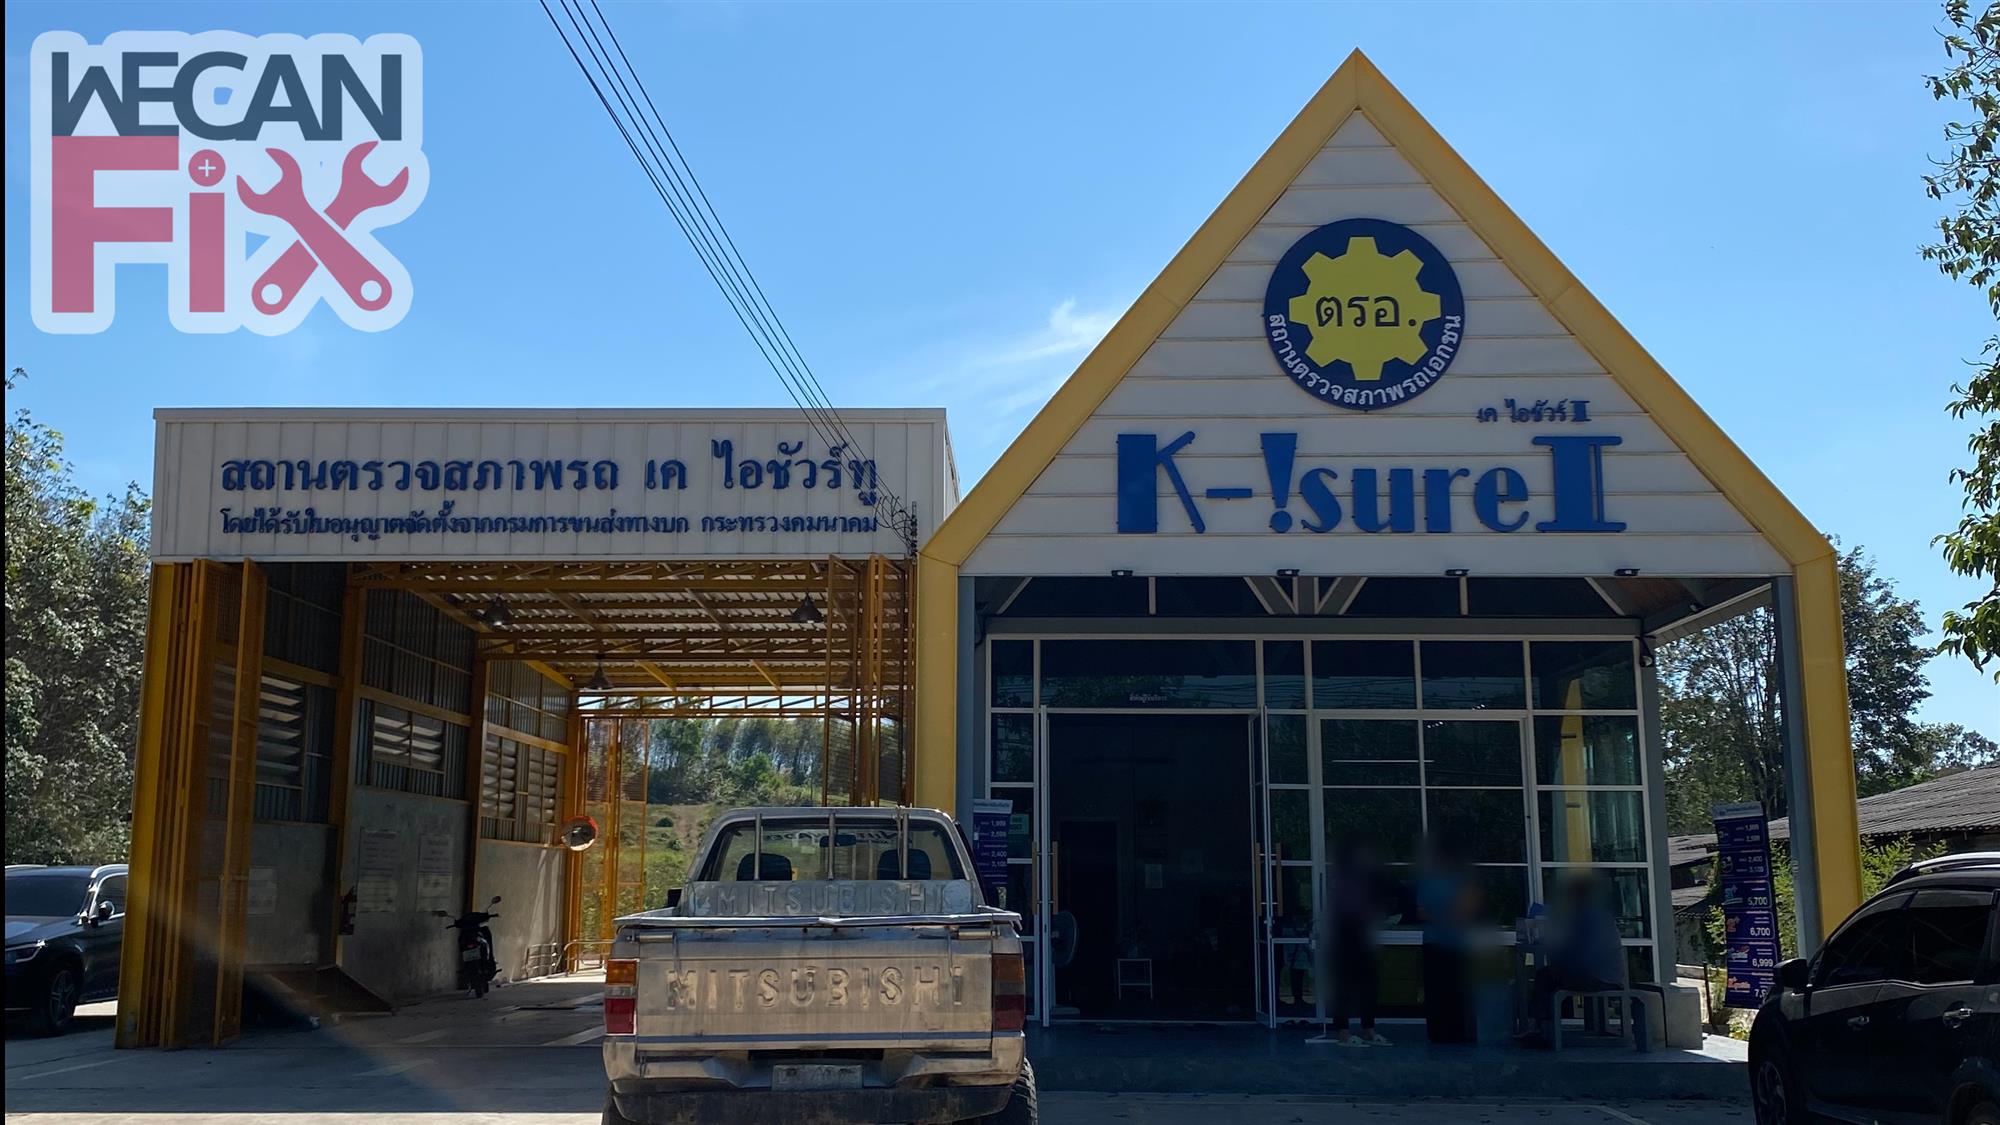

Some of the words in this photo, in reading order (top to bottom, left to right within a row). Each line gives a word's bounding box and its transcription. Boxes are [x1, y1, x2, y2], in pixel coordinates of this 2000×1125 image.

[1315, 295, 1417, 327] ตรอ.
[1269, 313, 1461, 405] สถานตรวจสภาพรถเอกชน
[1476, 407, 1498, 423] เค
[221, 459, 619, 491] สถานตรวจสภาพรถ
[645, 459, 688, 490] เค
[711, 439, 878, 506] ไอชัวร์ทู
[701, 514, 878, 534] กระทรวงคมนาคม
[1747, 896, 1768, 906] 5,700
[1750, 927, 1771, 936] 6,700
[1752, 958, 1774, 967] 6,999
[666, 965, 964, 1011] MITSUBISHI
